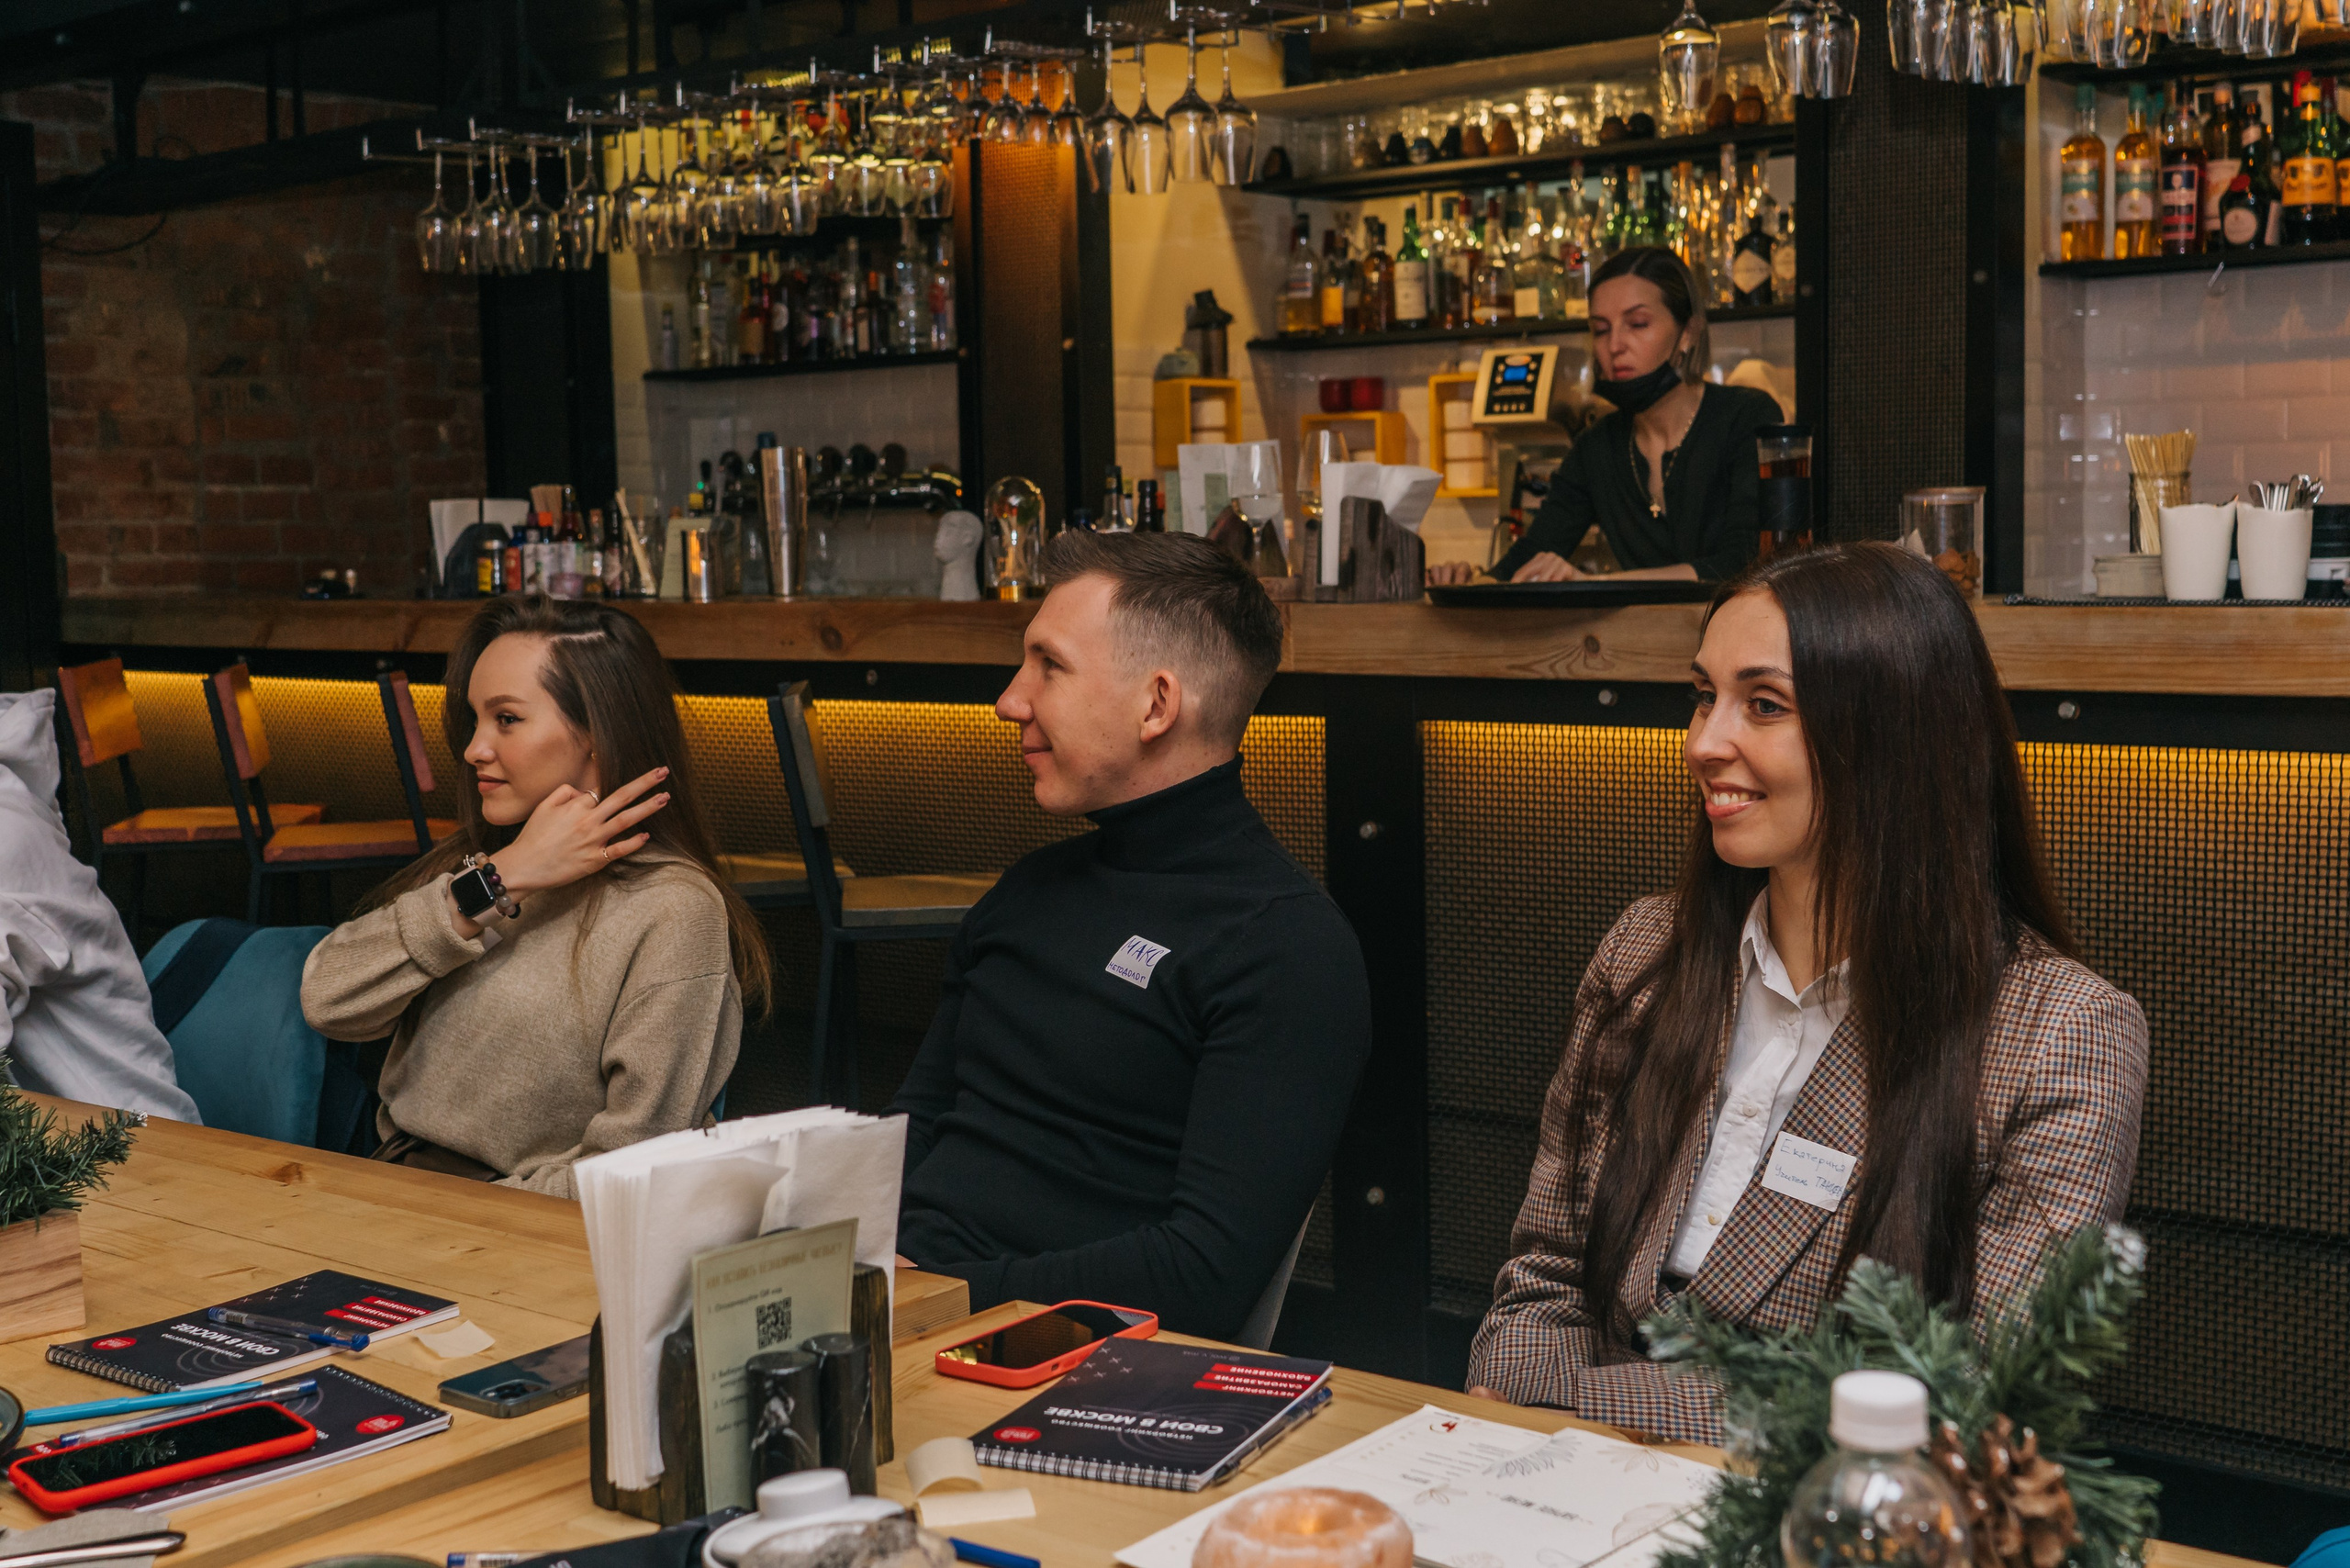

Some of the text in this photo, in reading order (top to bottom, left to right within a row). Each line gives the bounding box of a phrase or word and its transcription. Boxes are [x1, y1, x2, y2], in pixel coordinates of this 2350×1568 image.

[1120, 937, 1165, 967] МАКС
[1780, 1138, 1846, 1171] Екатерина
[352, 1305, 408, 1322] САМОРАЗВИТИЕ
[374, 1299, 426, 1316] ВДОХНОВЕНИЕ
[171, 1323, 231, 1342] МОСКВЕ
[236, 1340, 279, 1355] СВОИ
[1214, 1374, 1303, 1389] САМОРАЗВИТИЕ
[1230, 1367, 1311, 1381] ВДОХНОВЕНИЕ
[1222, 1384, 1294, 1397] НЕТВОРКИНГ
[1045, 1406, 1223, 1434] СВОИ В МОСКВЕ
[1051, 1418, 1193, 1440] НЕТВОРКИНГ СООБЩЕСТВО
